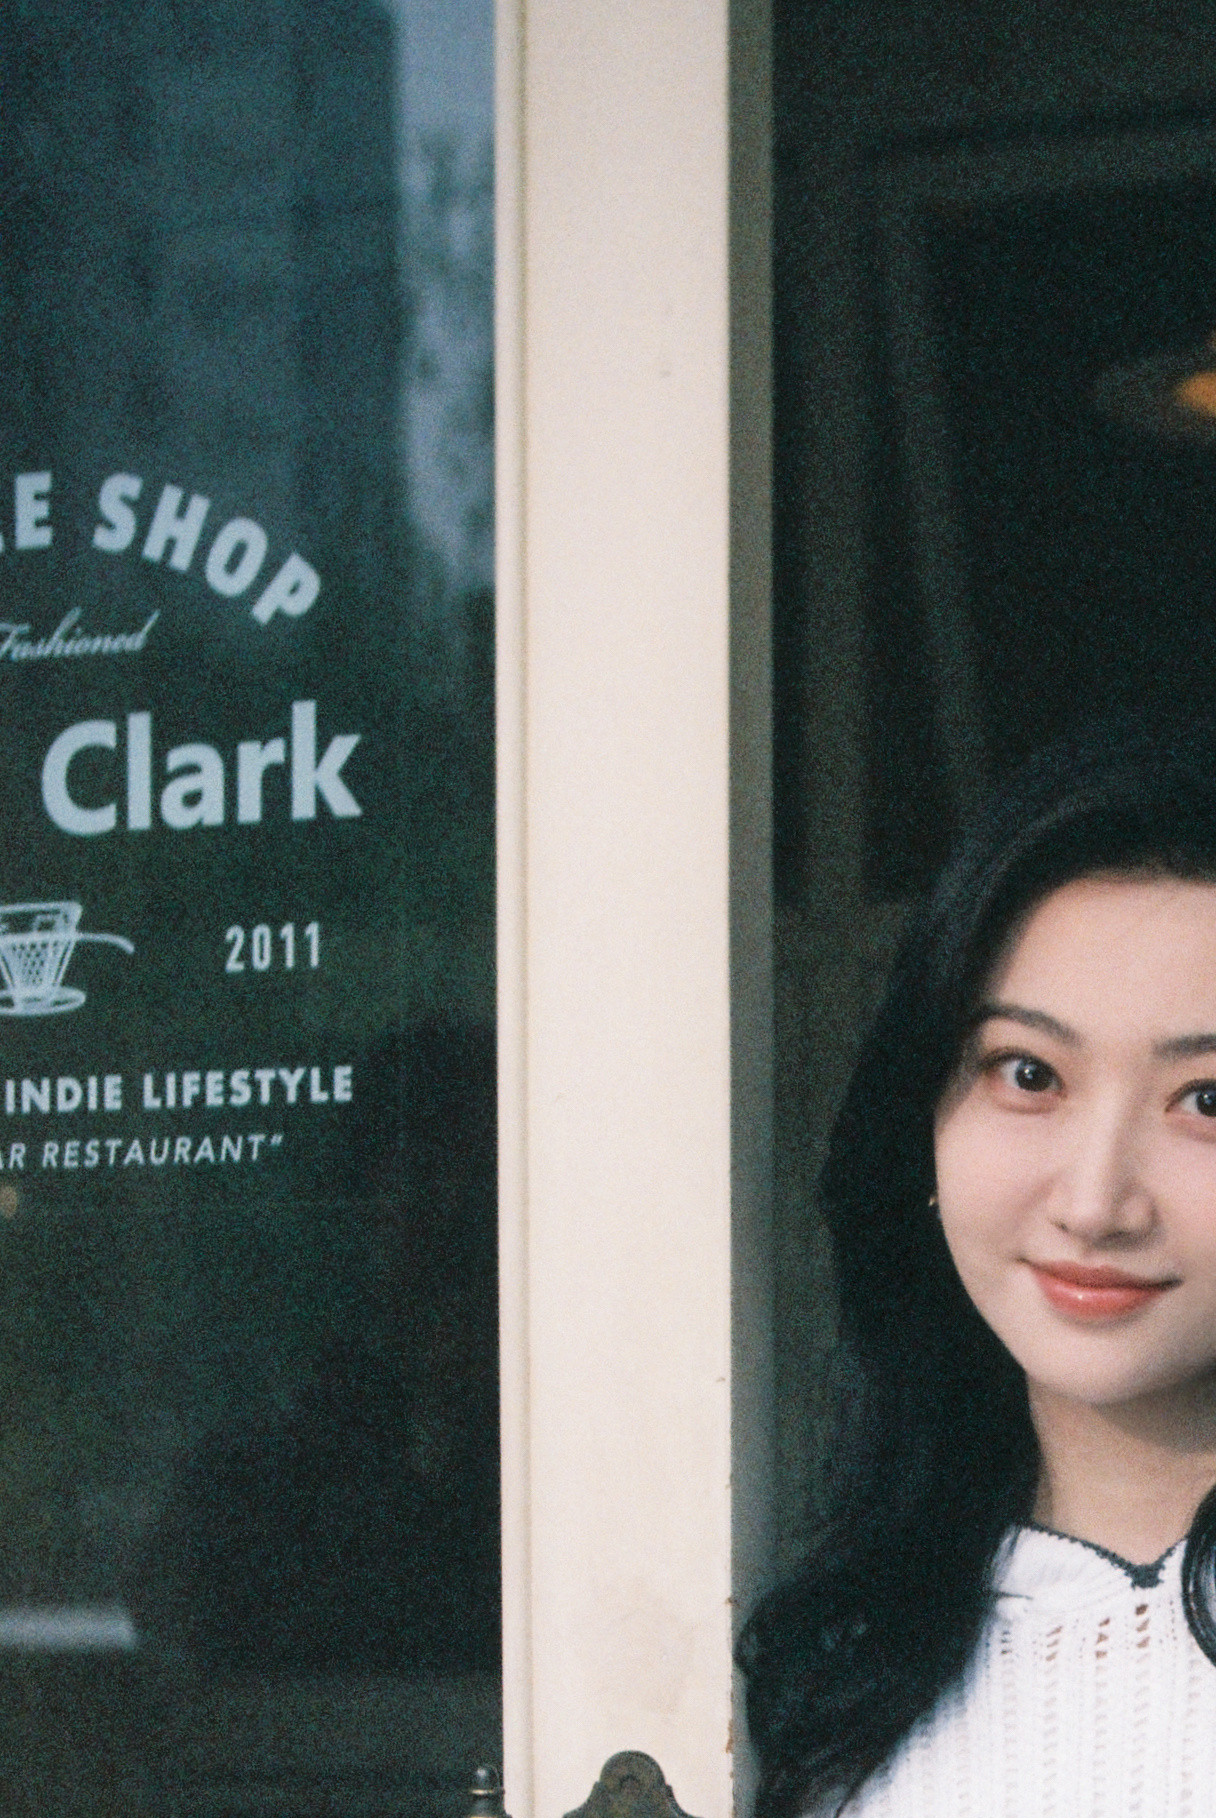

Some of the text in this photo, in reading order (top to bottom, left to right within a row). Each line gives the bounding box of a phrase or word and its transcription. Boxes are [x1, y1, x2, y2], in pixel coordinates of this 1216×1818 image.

[0, 470, 320, 626] E SHOP
[41, 700, 363, 837] Clark
[225, 921, 319, 973] 2011
[5, 1065, 353, 1114] INDIE LIFESTYLE
[0, 1141, 27, 1170] R
